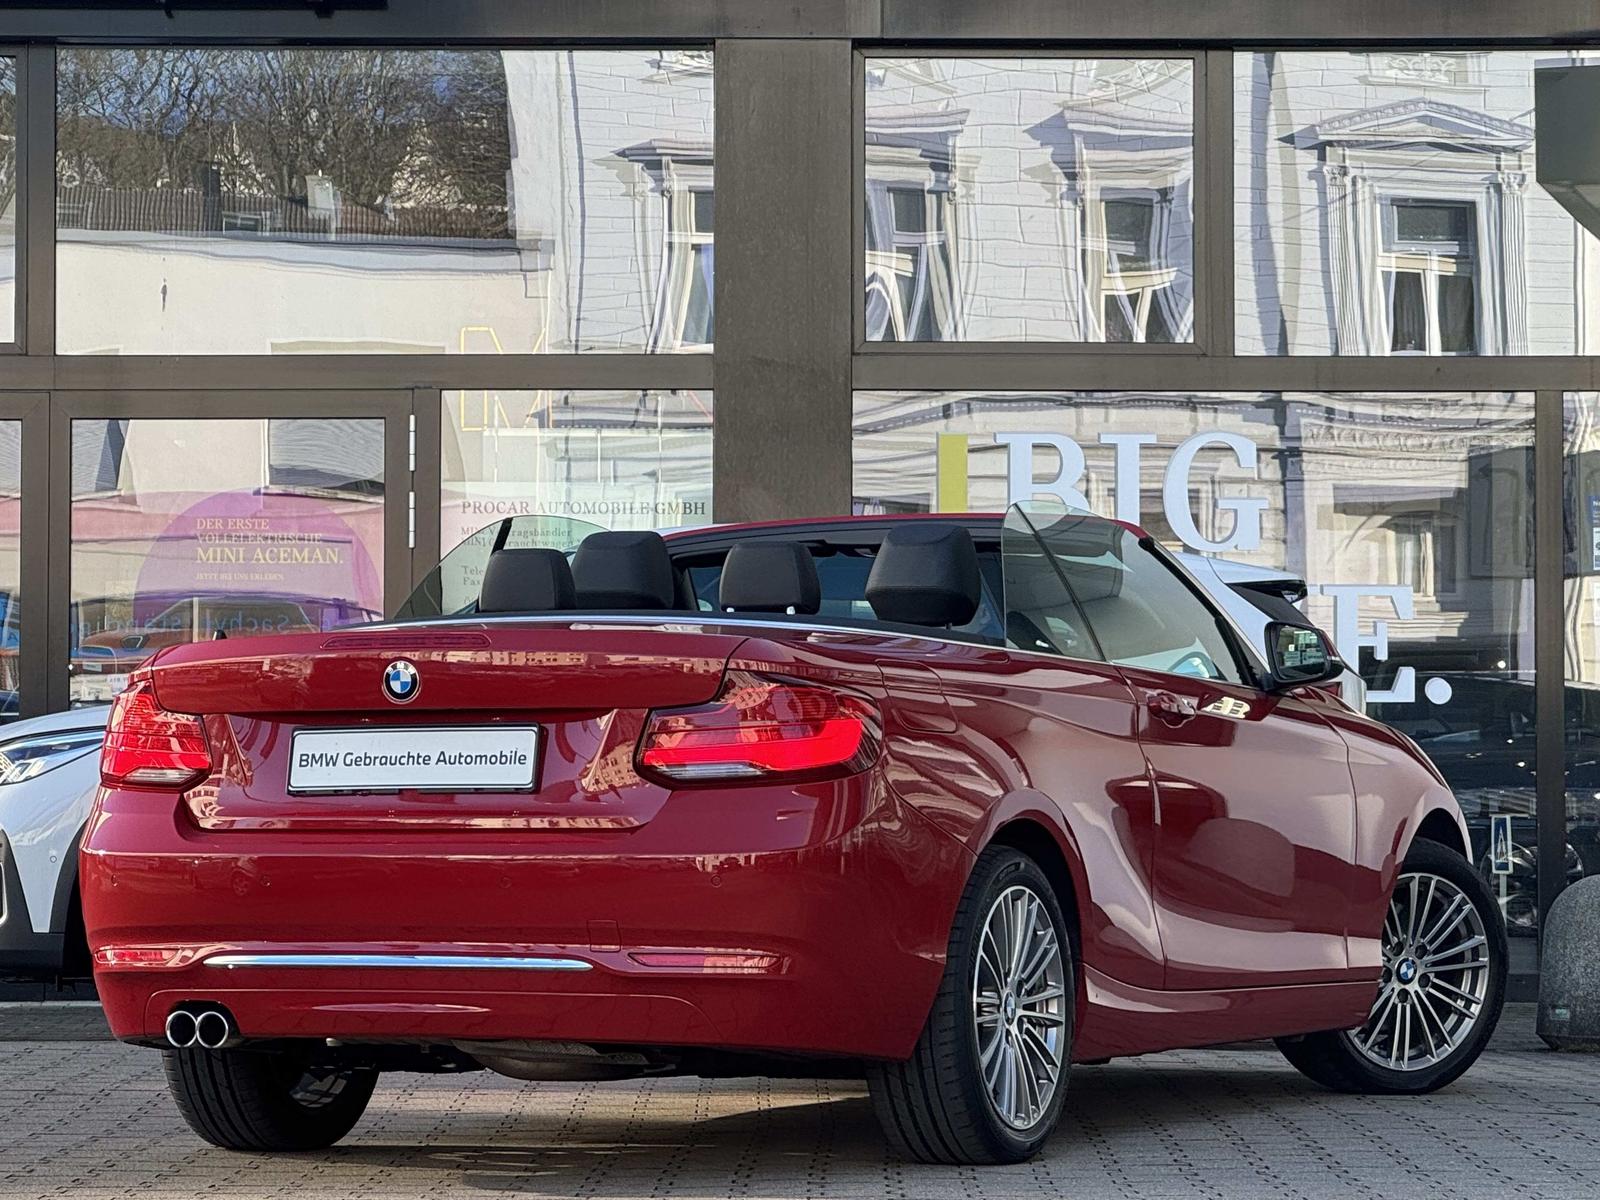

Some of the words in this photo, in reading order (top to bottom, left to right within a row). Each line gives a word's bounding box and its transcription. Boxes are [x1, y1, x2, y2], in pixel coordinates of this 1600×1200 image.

[994, 431, 1269, 552] BIG
[461, 501, 530, 515] PROCAR
[536, 501, 650, 515] AUTOMOBILE
[654, 501, 706, 515] GMBH
[196, 518, 223, 529] DER
[227, 518, 269, 529] ERSTE
[196, 532, 322, 544] VOLLELEKTRISCHE
[196, 547, 245, 564] MINI
[252, 547, 343, 564] ACEMAN.
[298, 753, 339, 768] BMW
[343, 750, 432, 767] Gebrauchte
[435, 749, 528, 766] Automobile
